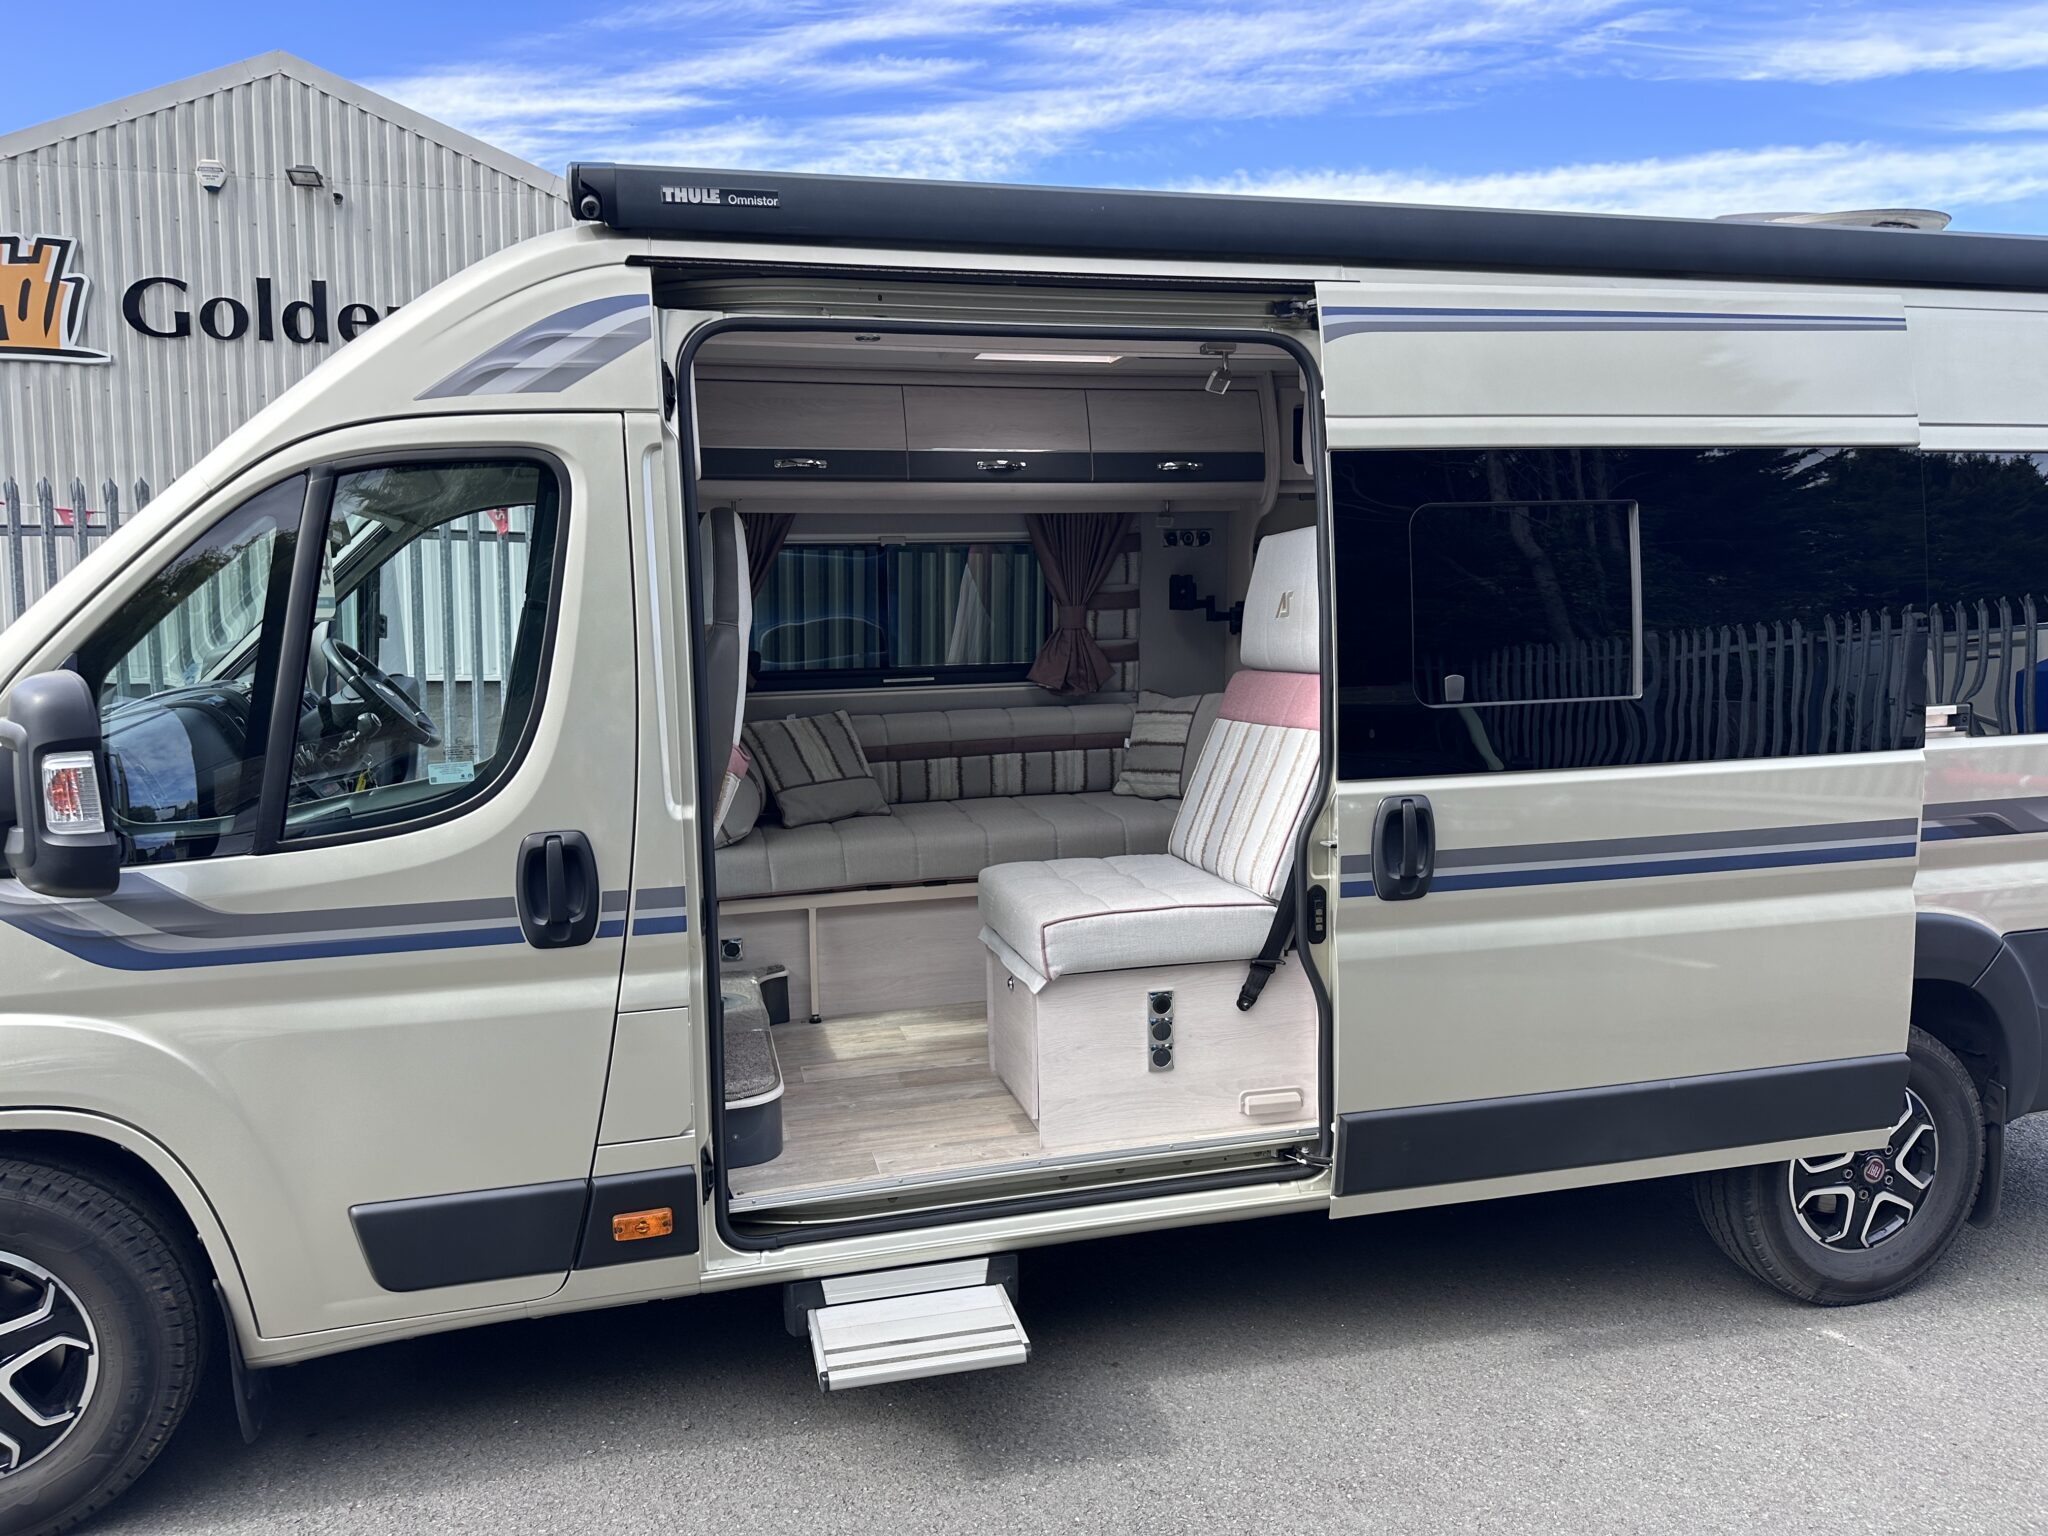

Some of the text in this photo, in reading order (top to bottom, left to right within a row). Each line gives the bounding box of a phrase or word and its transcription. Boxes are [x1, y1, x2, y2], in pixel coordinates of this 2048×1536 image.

[662, 187, 779, 207] THULE Omnistor
[122, 276, 401, 345] Golde
